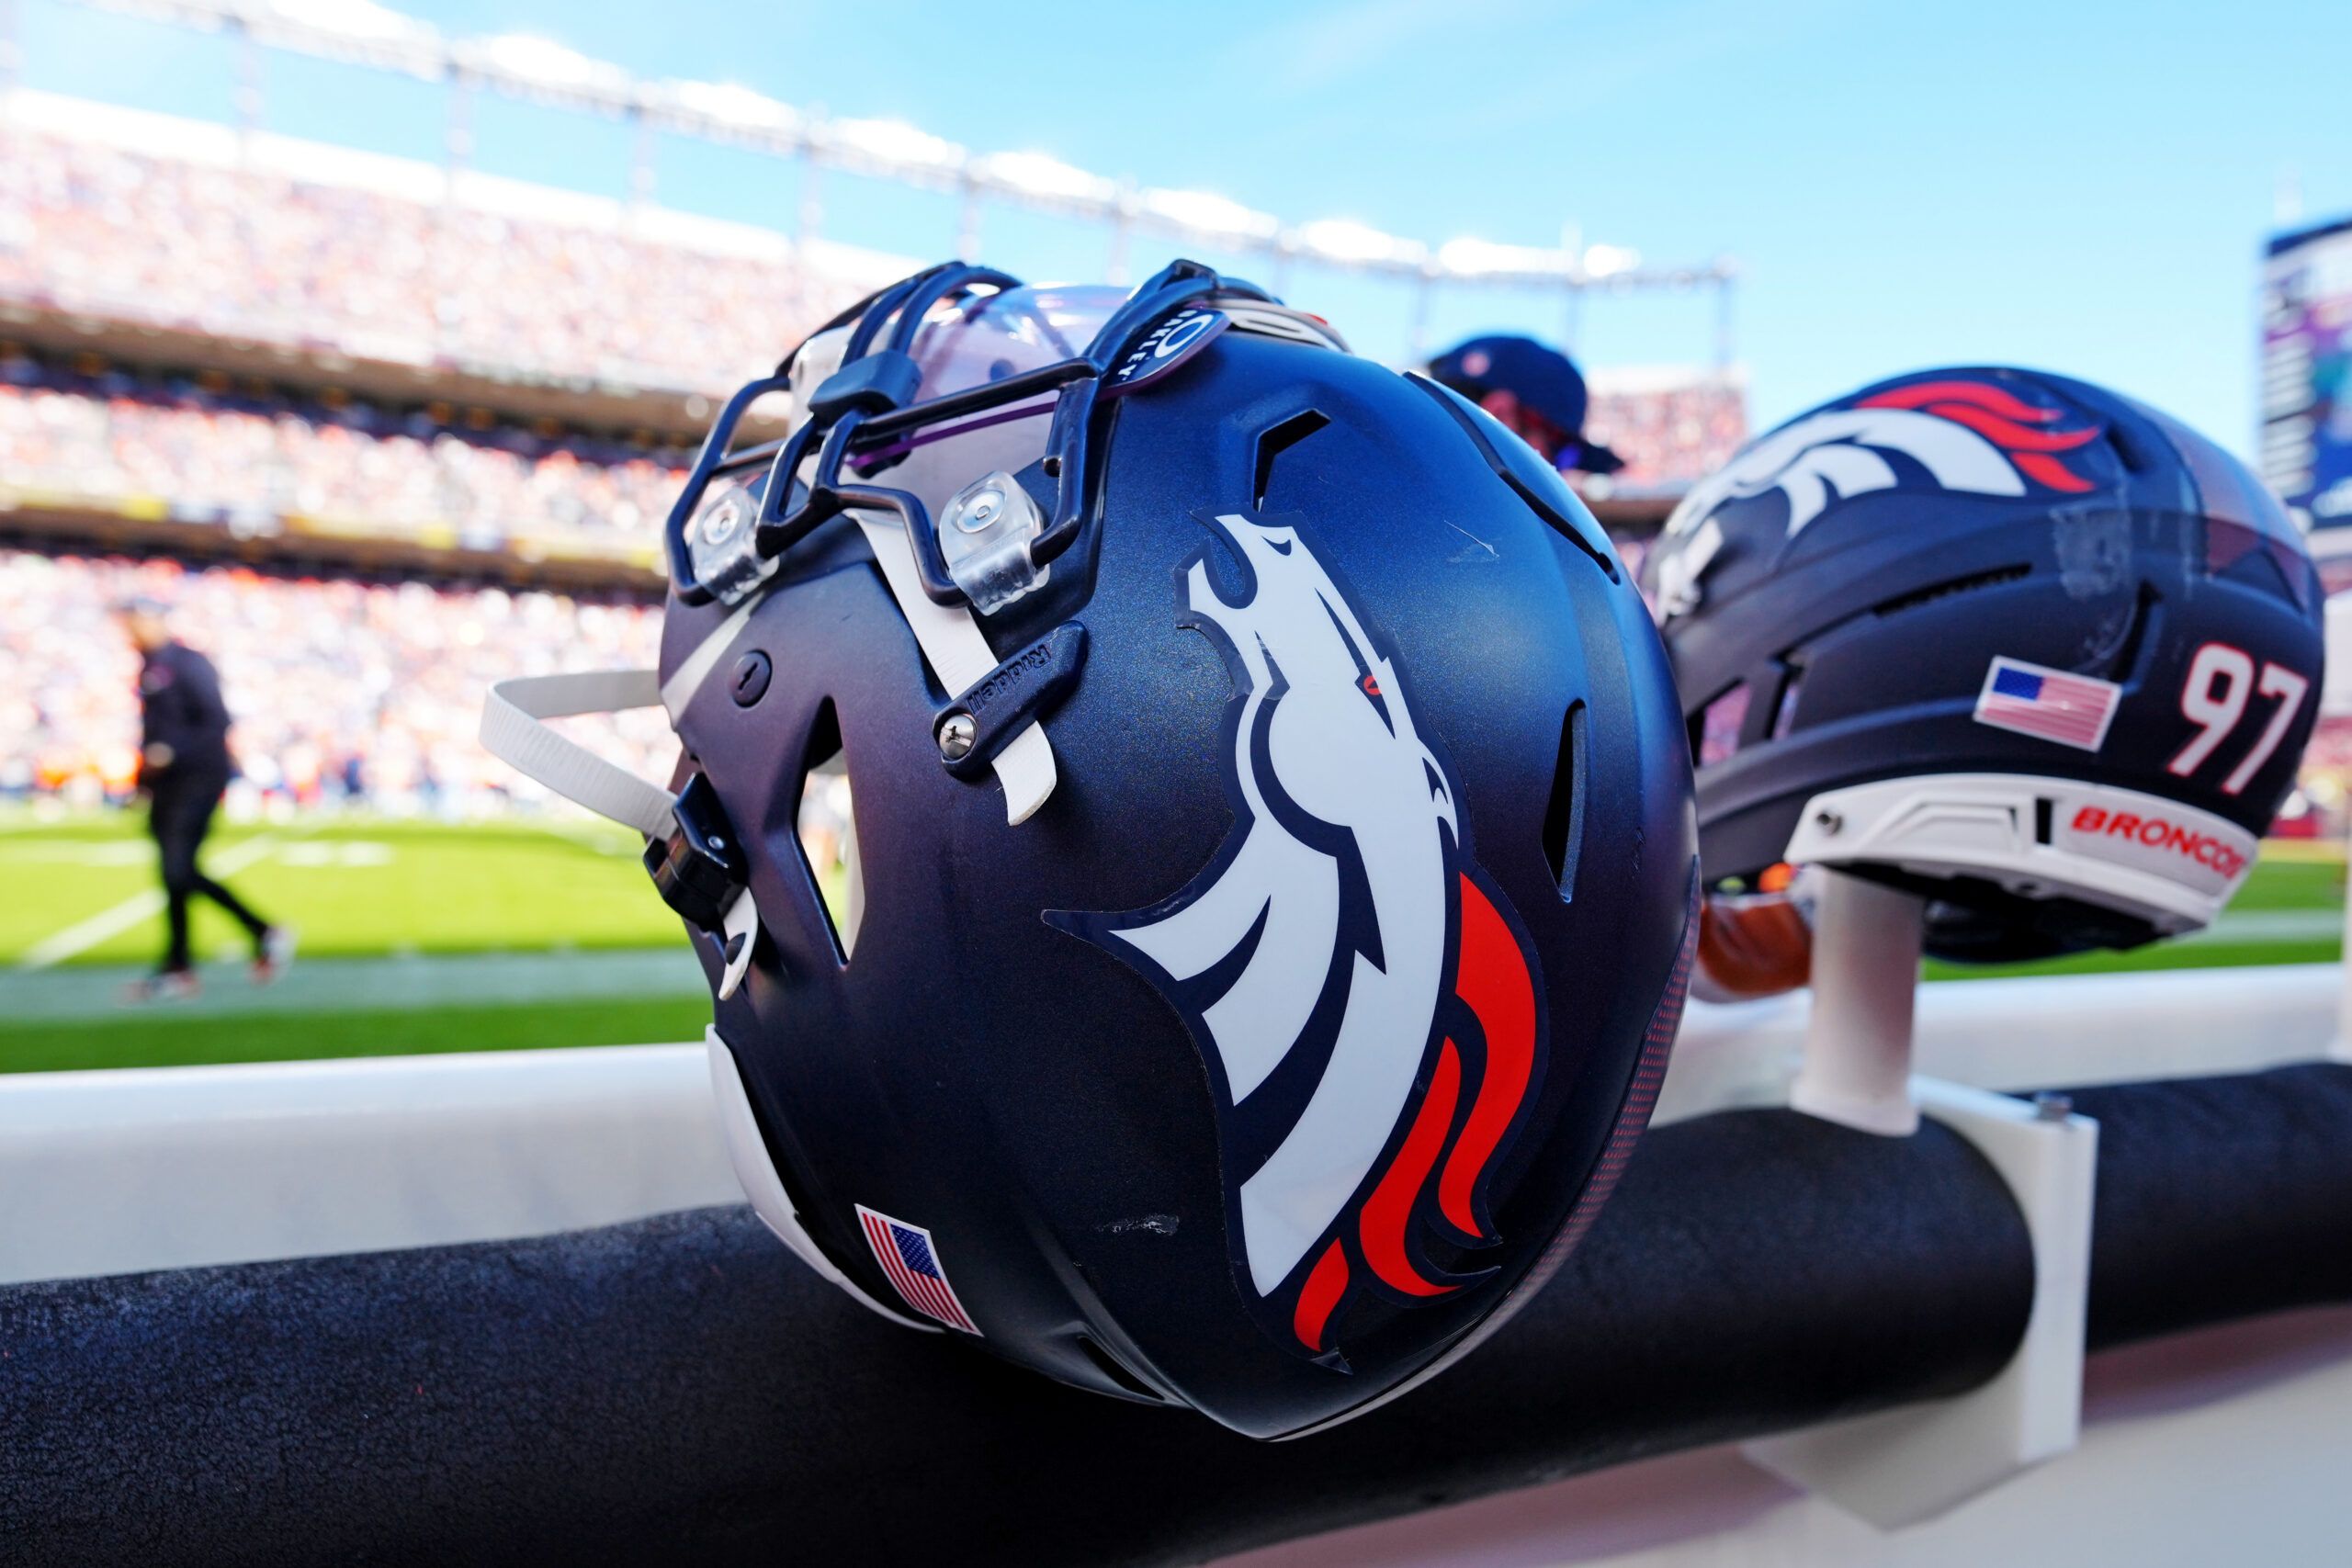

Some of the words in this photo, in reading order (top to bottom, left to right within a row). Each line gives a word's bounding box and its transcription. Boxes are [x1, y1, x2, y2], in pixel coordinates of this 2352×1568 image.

[1118, 310, 1197, 376] OAKLEY
[967, 644, 1052, 714] Riddell
[2167, 641, 2309, 795] 97
